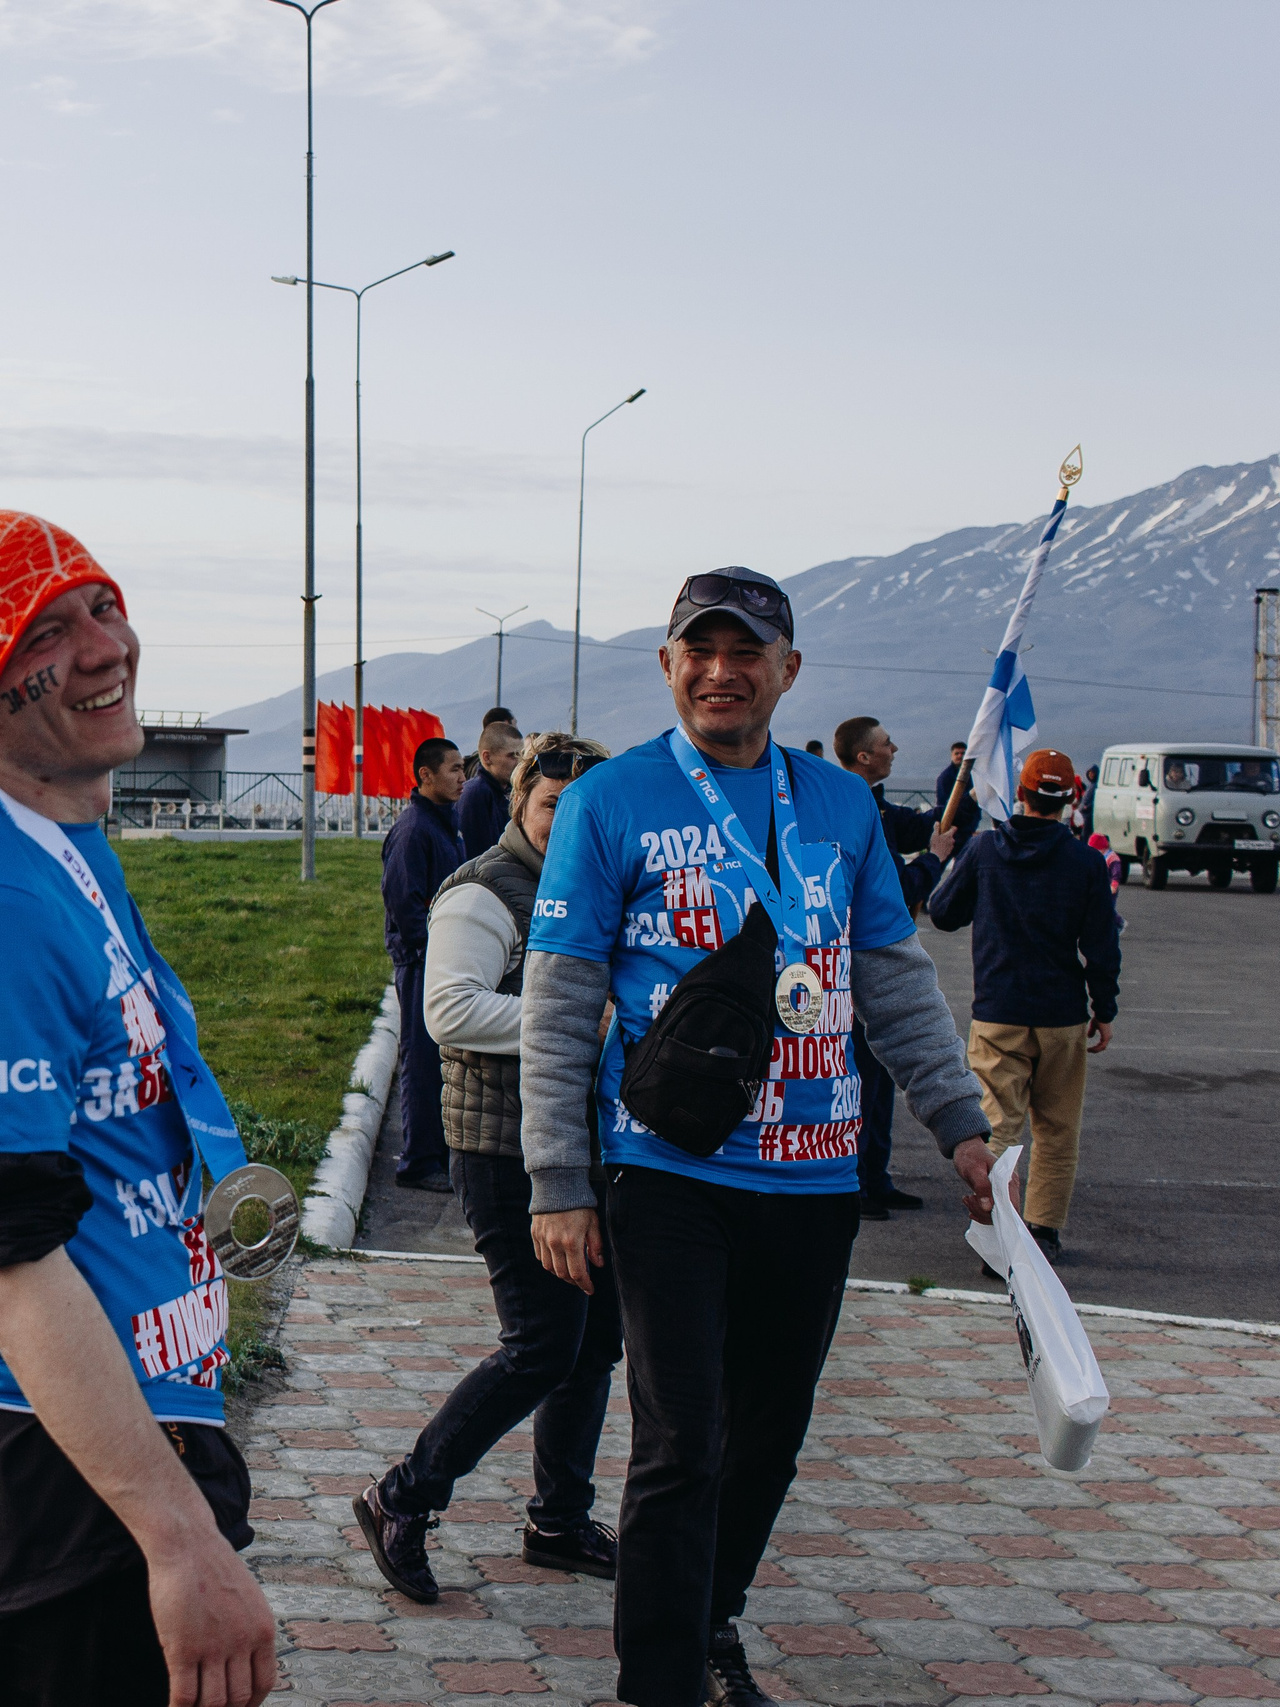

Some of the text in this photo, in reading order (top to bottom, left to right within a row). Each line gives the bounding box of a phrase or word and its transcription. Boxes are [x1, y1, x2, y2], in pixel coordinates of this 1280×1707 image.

[777, 769, 787, 791] ПСБ
[699, 780, 719, 804] ПСБ
[640, 824, 726, 873] 2024
[533, 899, 568, 918] ПСБ
